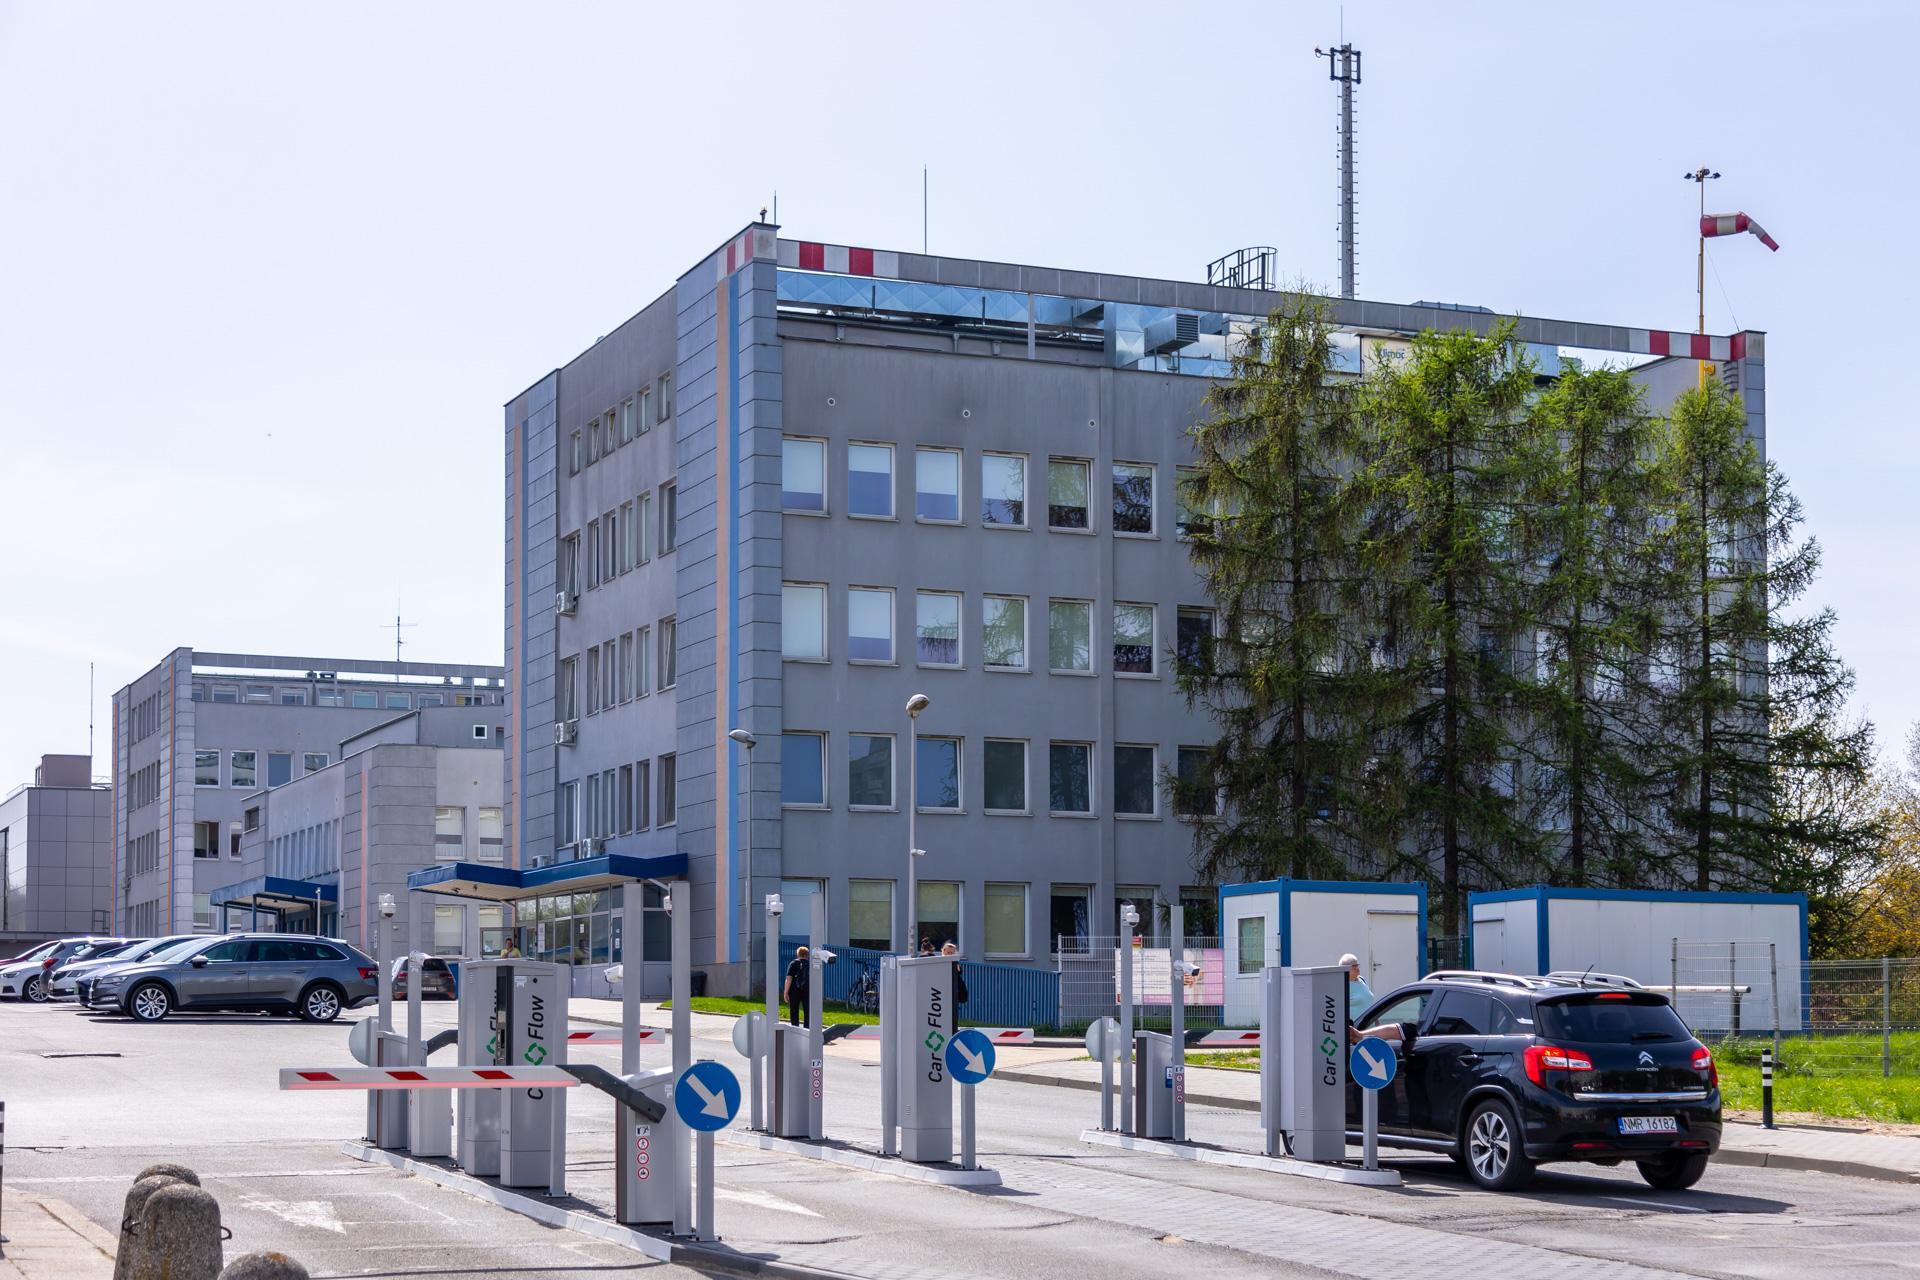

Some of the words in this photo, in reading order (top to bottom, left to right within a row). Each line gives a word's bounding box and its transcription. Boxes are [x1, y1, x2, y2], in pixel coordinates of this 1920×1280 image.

[527, 995, 544, 1040] Flow
[928, 987, 942, 1028] Flow
[1323, 995, 1336, 1034] Flow
[928, 1053, 942, 1083] Car
[1323, 1057, 1336, 1086] Car
[1624, 1117, 1644, 1130] NMR
[1647, 1117, 1676, 1130] 16182
